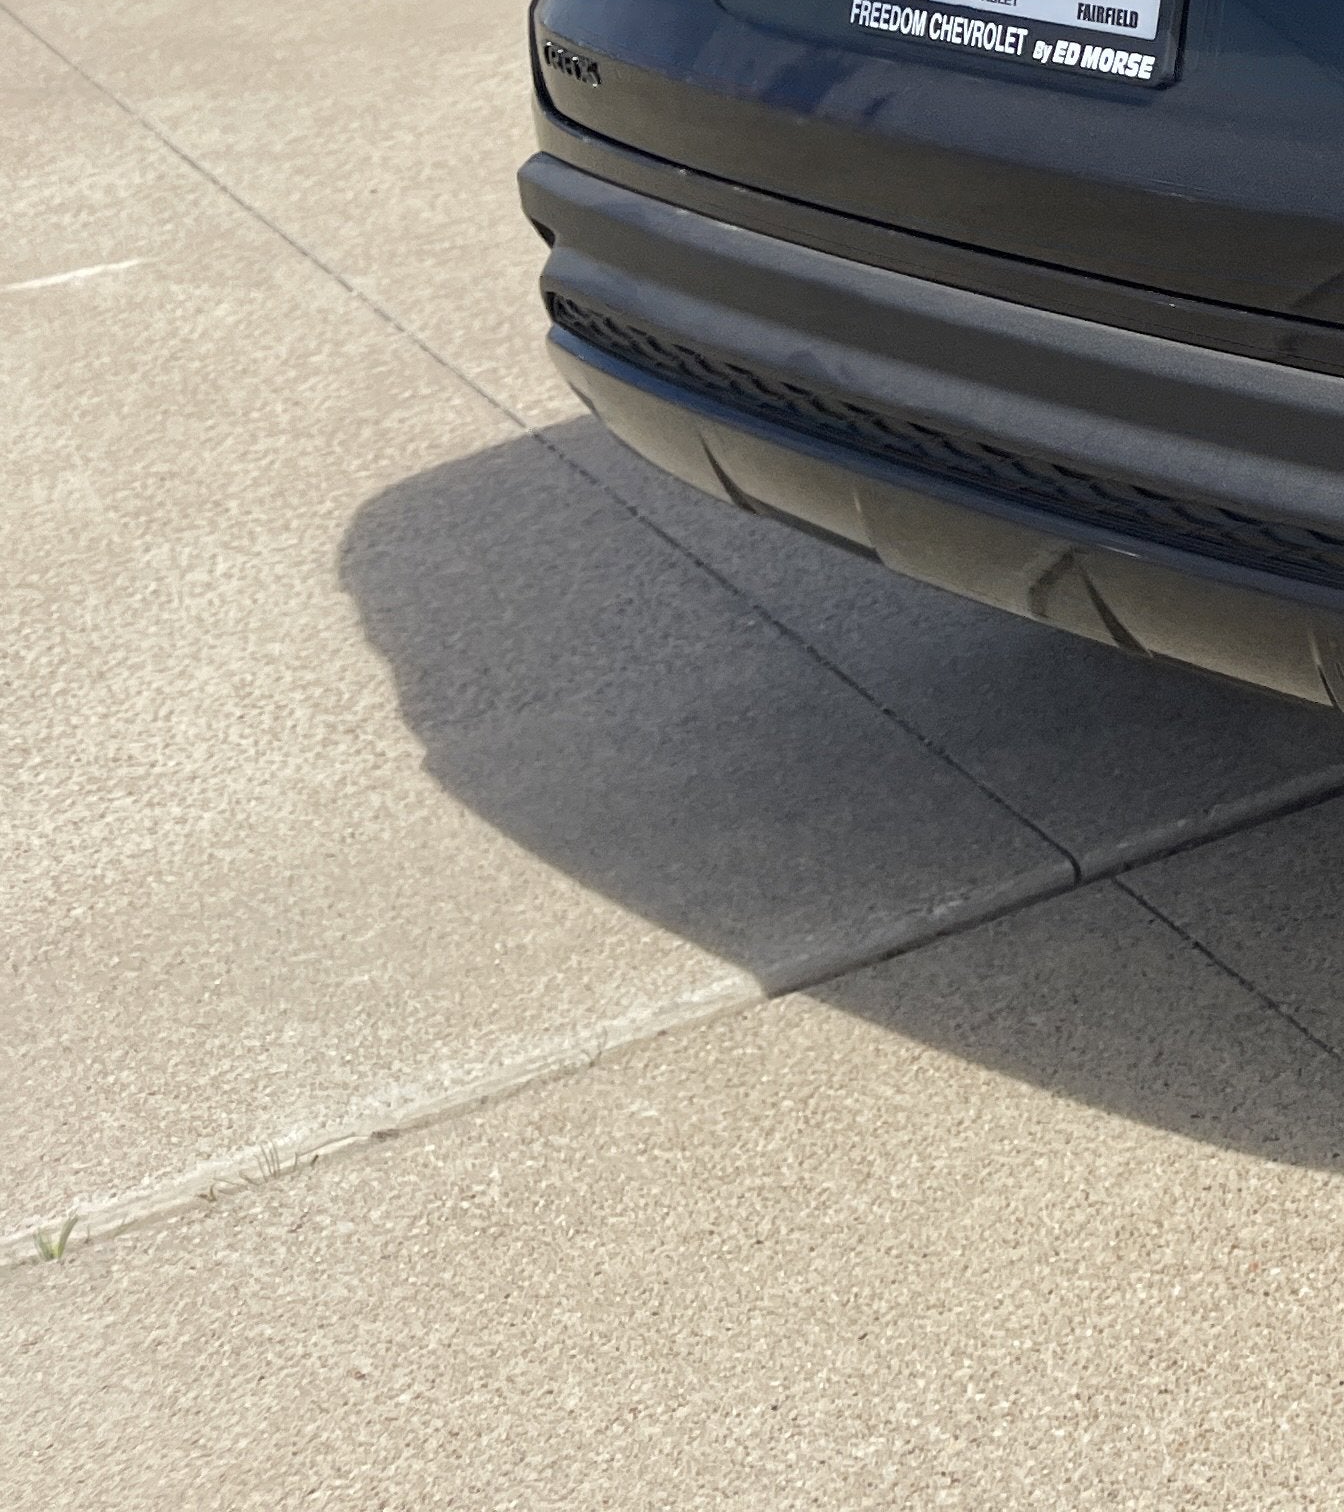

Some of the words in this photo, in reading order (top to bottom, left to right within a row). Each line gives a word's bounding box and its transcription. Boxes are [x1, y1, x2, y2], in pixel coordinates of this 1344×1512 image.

[1077, 2, 1139, 29] FAIRFIELD
[929, 12, 1028, 56] CHEVROLET
[1052, 39, 1081, 66] ED
[1080, 45, 1156, 80] MORSE
